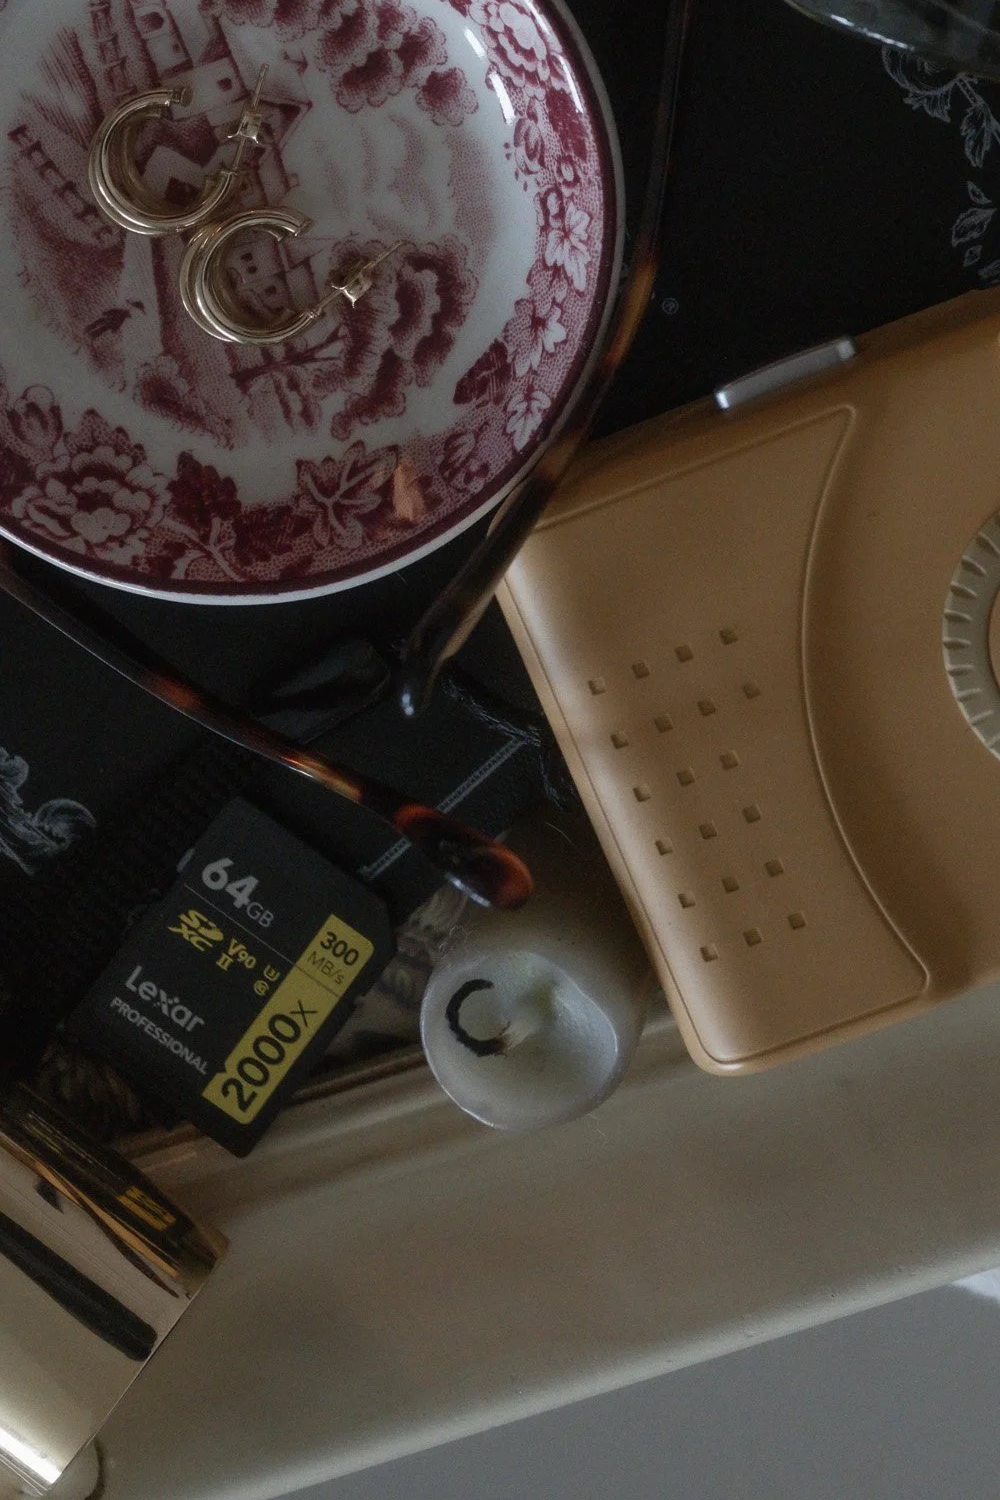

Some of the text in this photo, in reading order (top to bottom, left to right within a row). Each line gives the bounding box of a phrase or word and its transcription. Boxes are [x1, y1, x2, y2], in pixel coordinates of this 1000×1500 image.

[306, 950, 346, 986] MB/s
[320, 931, 360, 966] 300
[124, 964, 206, 1033] Lexar
[109, 996, 209, 1077] PROFESSIONAL
